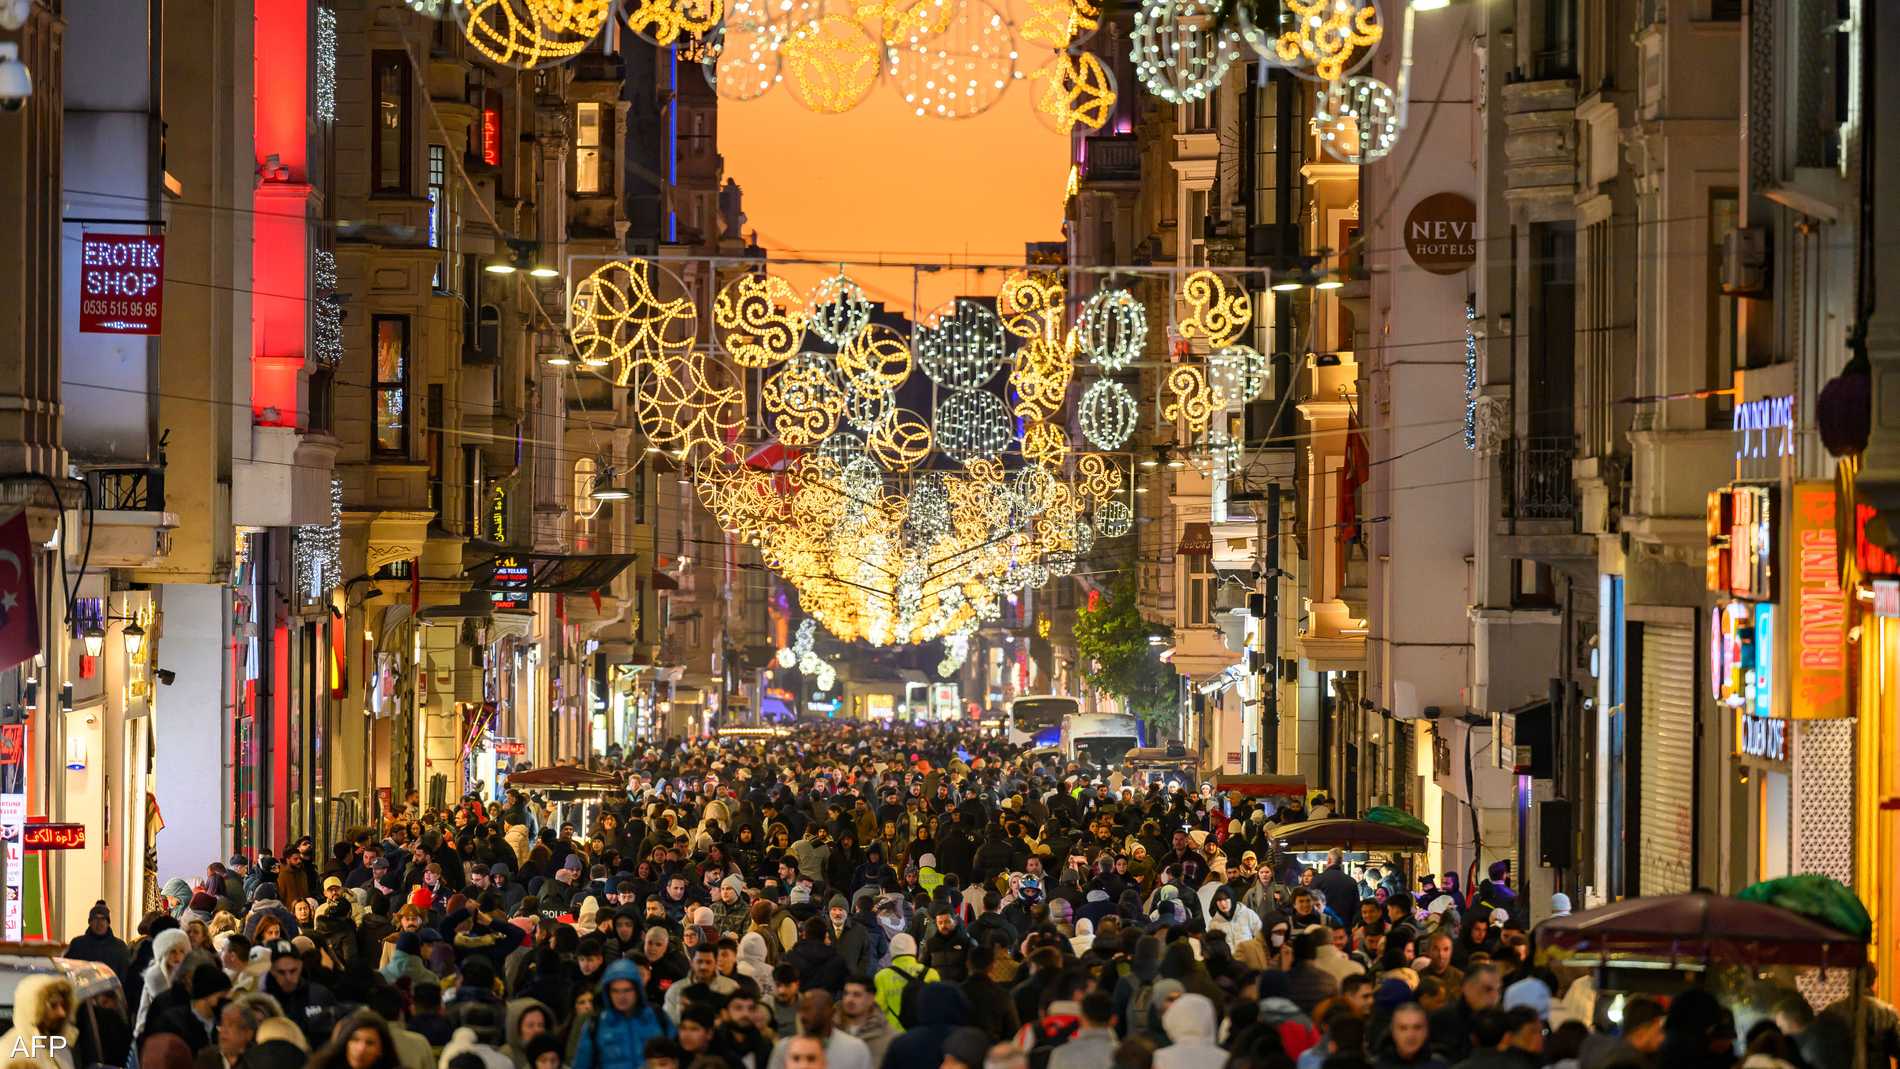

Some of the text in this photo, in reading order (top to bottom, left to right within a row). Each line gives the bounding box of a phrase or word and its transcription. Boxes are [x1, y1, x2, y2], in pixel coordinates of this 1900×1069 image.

[85, 240, 160, 267] EROTİK
[1416, 243, 1475, 255] HOTELS
[87, 271, 157, 296] SHOP
[83, 300, 157, 317] 0535 515 95 95
[1800, 528, 1845, 671] BOWLING
[24, 827, 85, 847] قراءة الكف
